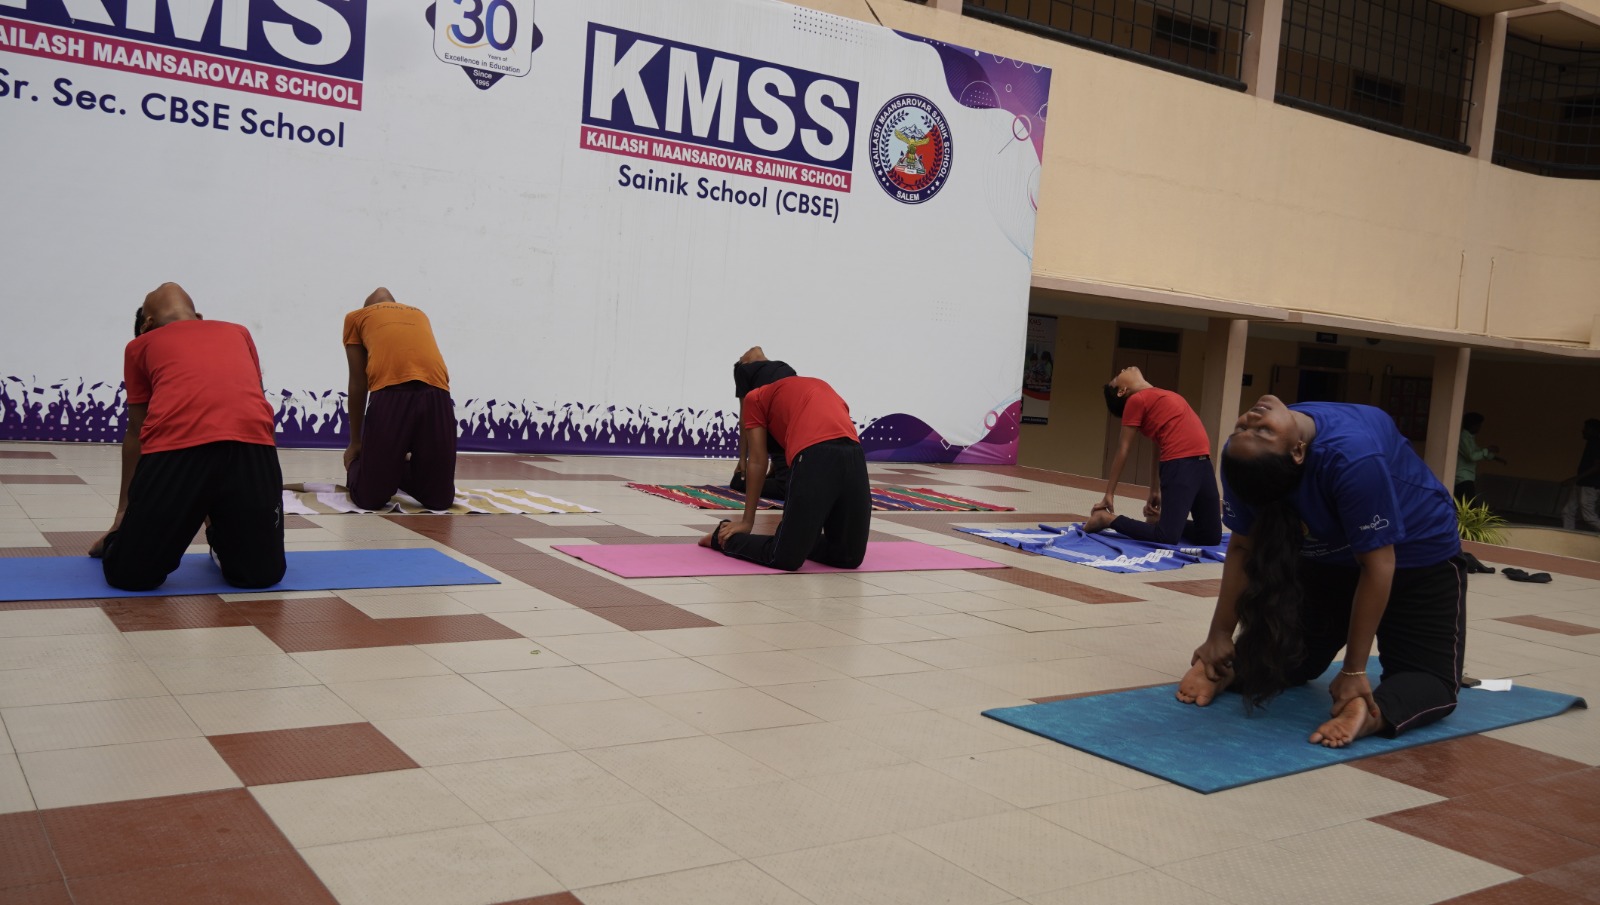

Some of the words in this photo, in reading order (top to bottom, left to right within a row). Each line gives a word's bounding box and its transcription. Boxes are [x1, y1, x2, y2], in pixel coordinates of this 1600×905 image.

[451, 0, 517, 51] 30
[93, 41, 269, 90] MAANSAROVAR
[275, 76, 359, 105] SCHOOL
[444, 52, 480, 66] Excellence
[489, 61, 521, 74] Education
[473, 69, 493, 80] Since
[488, 53, 502, 61] Years
[52, 77, 127, 116] Sec.
[140, 92, 230, 131] CBSE
[239, 107, 345, 148] School
[589, 30, 850, 161] KMSS
[878, 98, 932, 126] MAANSAROVAR
[931, 110, 949, 140] SAINIK
[586, 130, 649, 155] KAILASH
[652, 143, 753, 173] MAANSAROVAR
[755, 160, 798, 181] SAINIK
[800, 168, 848, 190] SCHOOL
[872, 124, 882, 168] KAILASH
[938, 141, 951, 179] SCHOOL
[617, 164, 688, 197] Sainik
[696, 177, 768, 209] School
[775, 188, 840, 224] (CBSE)
[896, 190, 920, 201] SALEM
